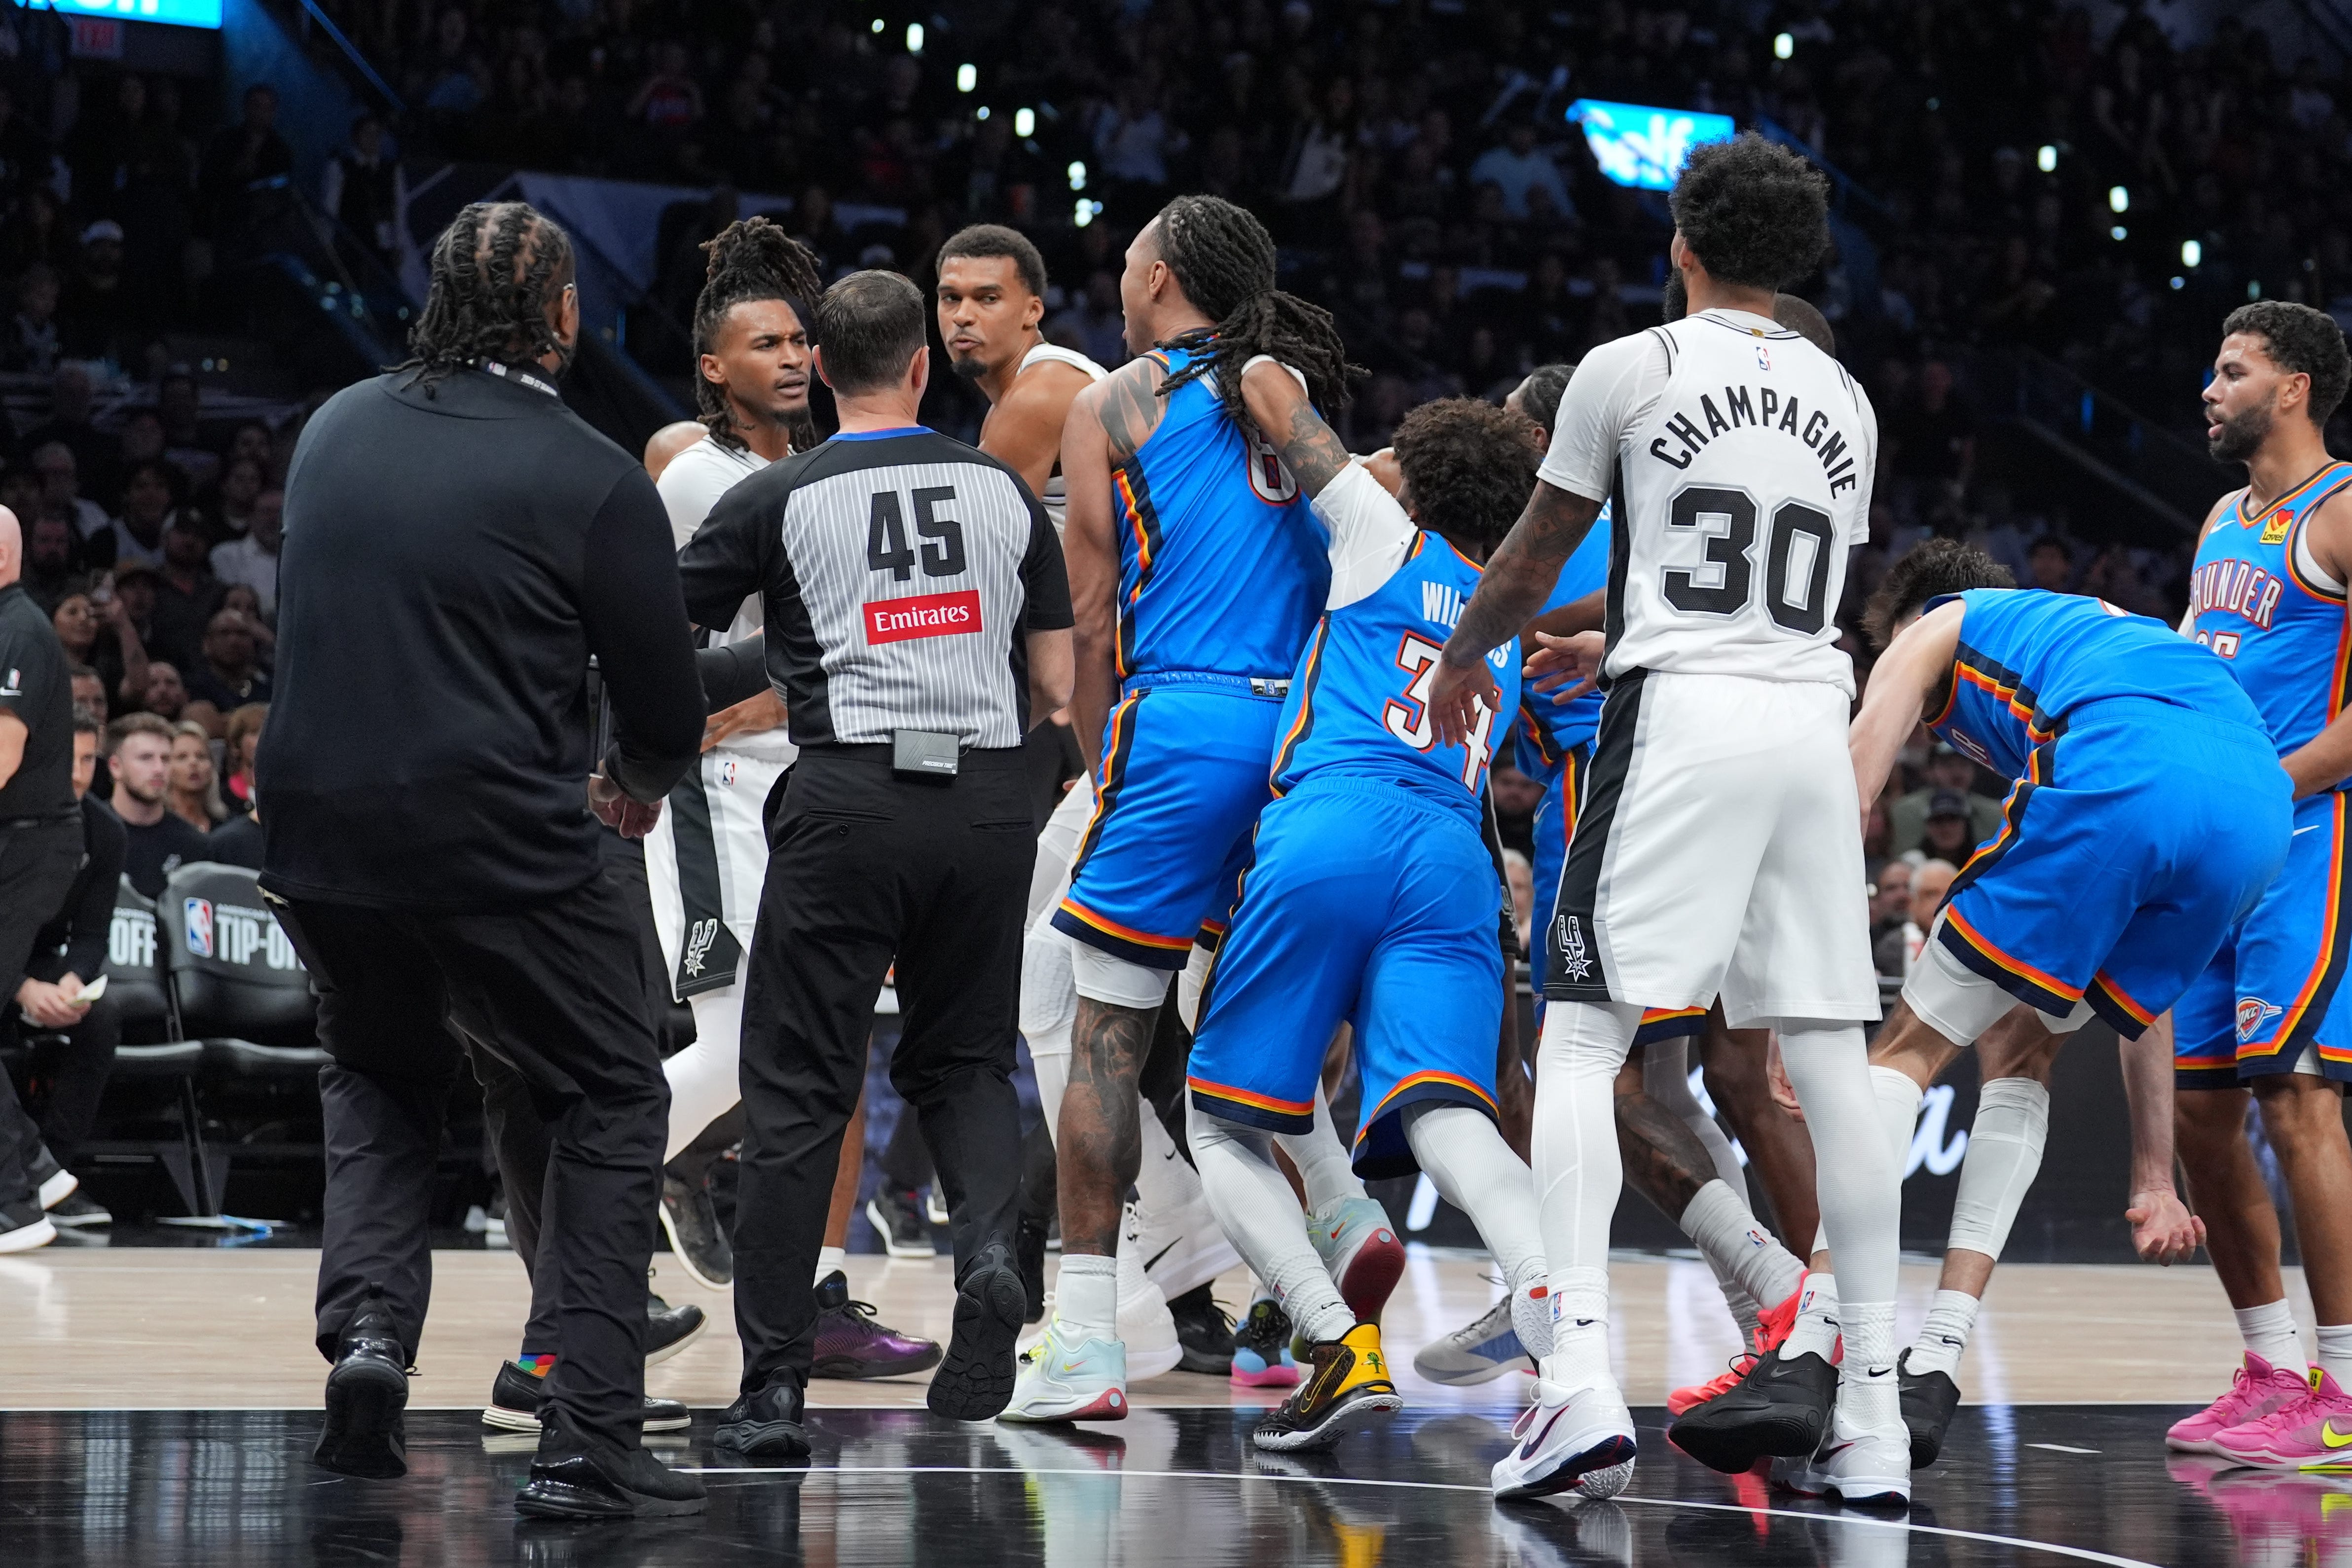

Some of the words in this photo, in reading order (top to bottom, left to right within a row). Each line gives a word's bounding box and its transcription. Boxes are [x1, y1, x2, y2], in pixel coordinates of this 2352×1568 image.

[1650, 385, 1856, 500] CHAMPAGNIE
[867, 485, 966, 582] 45
[1658, 481, 1838, 640] 30
[874, 605, 970, 632] Emirates
[1422, 580, 1512, 668] WILS
[2190, 558, 2284, 632] HUNDER
[1383, 629, 1503, 797] 34
[215, 913, 308, 971] TIP-O
